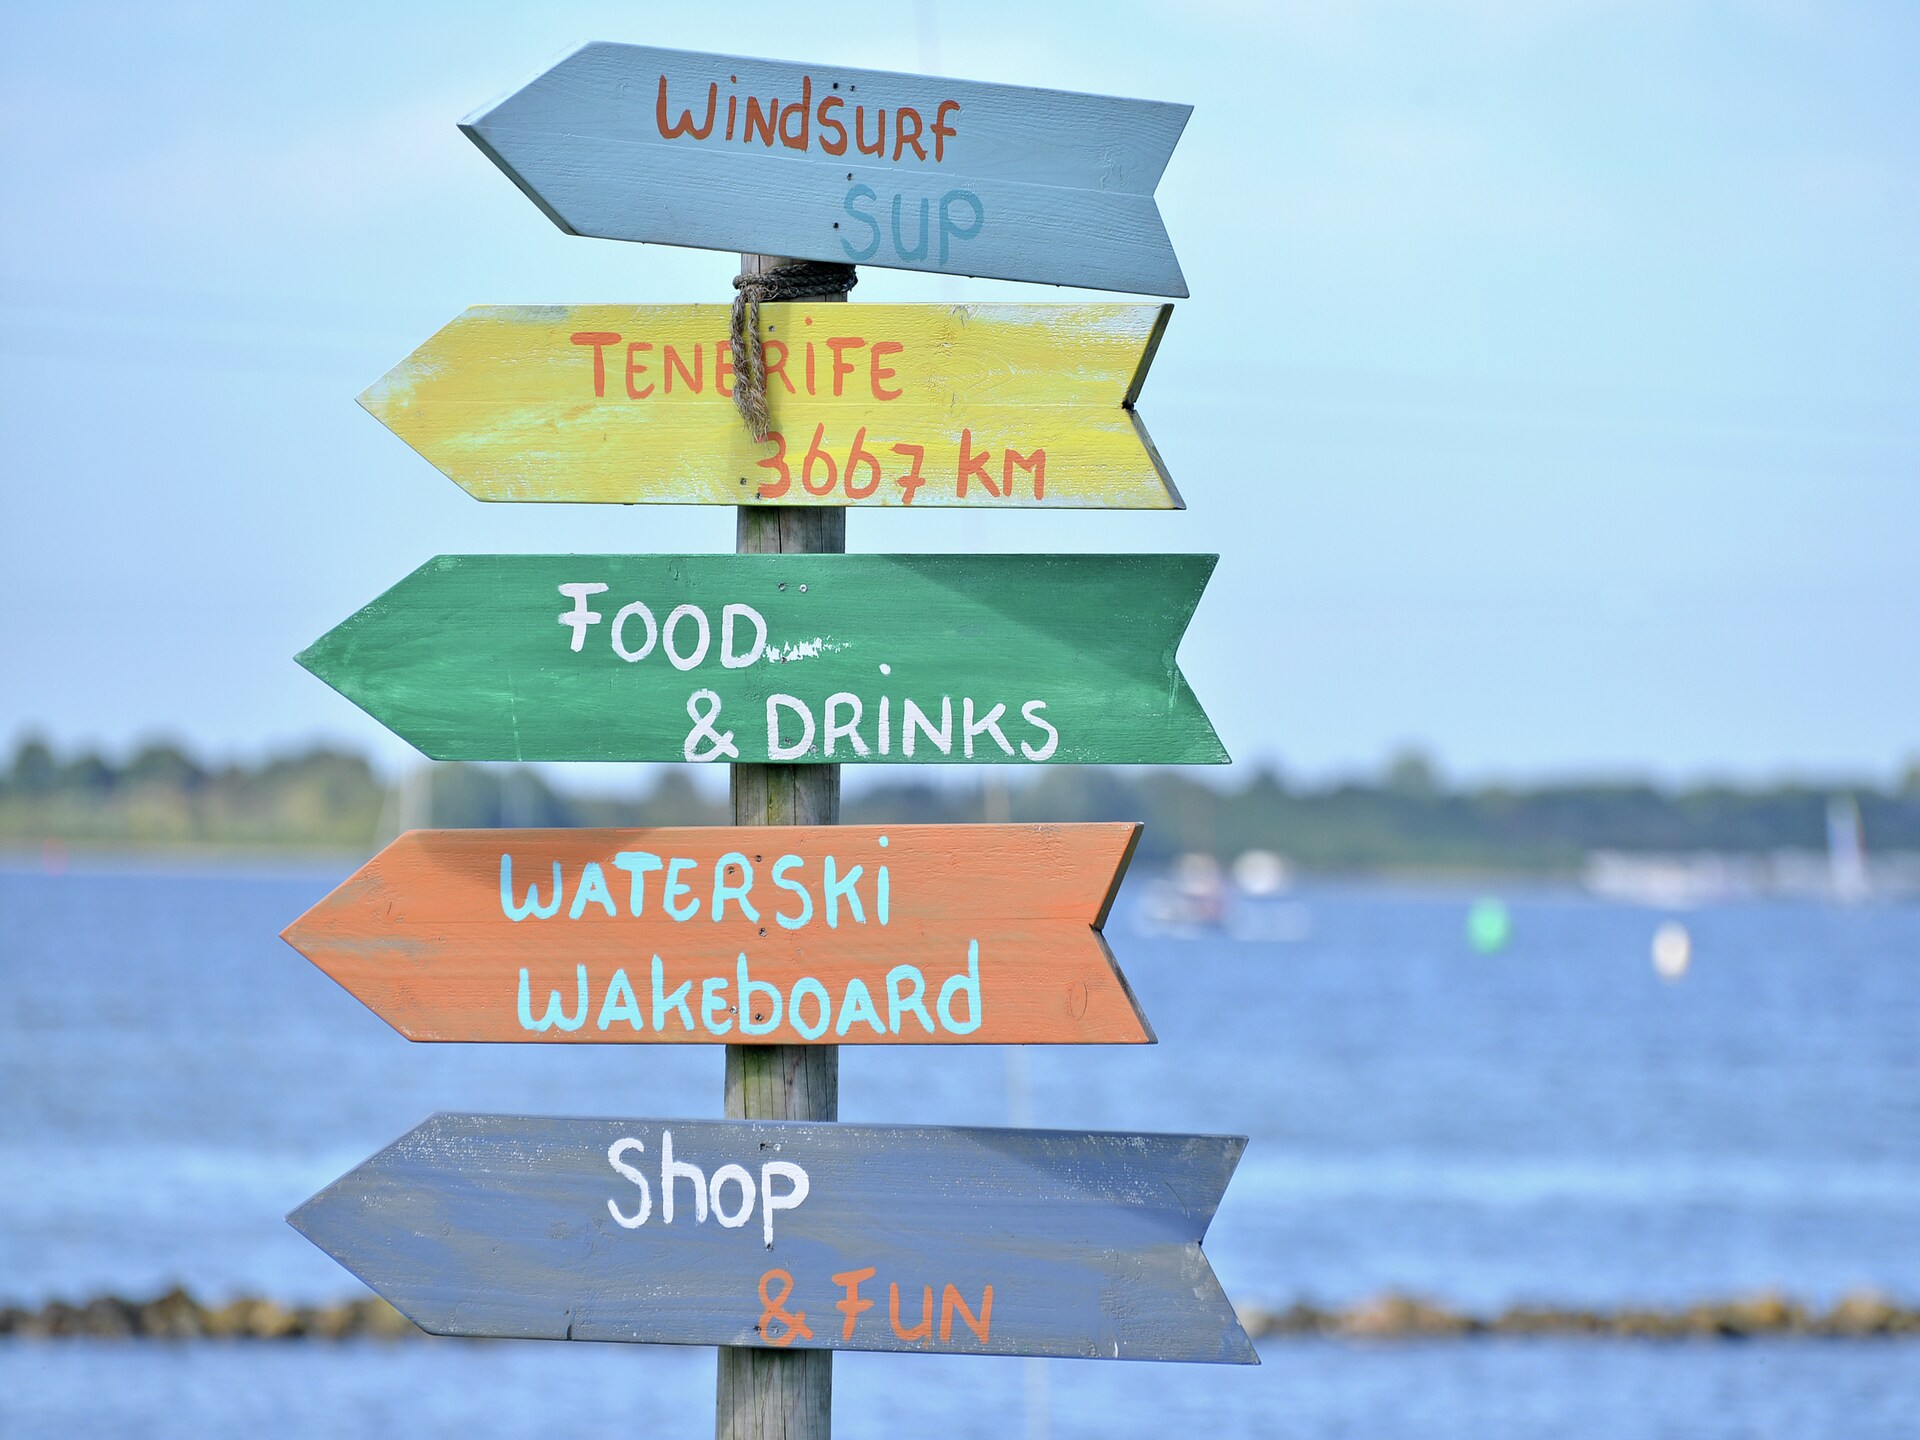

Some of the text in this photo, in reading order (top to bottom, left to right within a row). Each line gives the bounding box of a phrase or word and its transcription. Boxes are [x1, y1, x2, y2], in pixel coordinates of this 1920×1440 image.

[755, 423, 927, 504] 3667
[684, 689, 739, 762] &
[757, 1267, 994, 1348] & FUN
